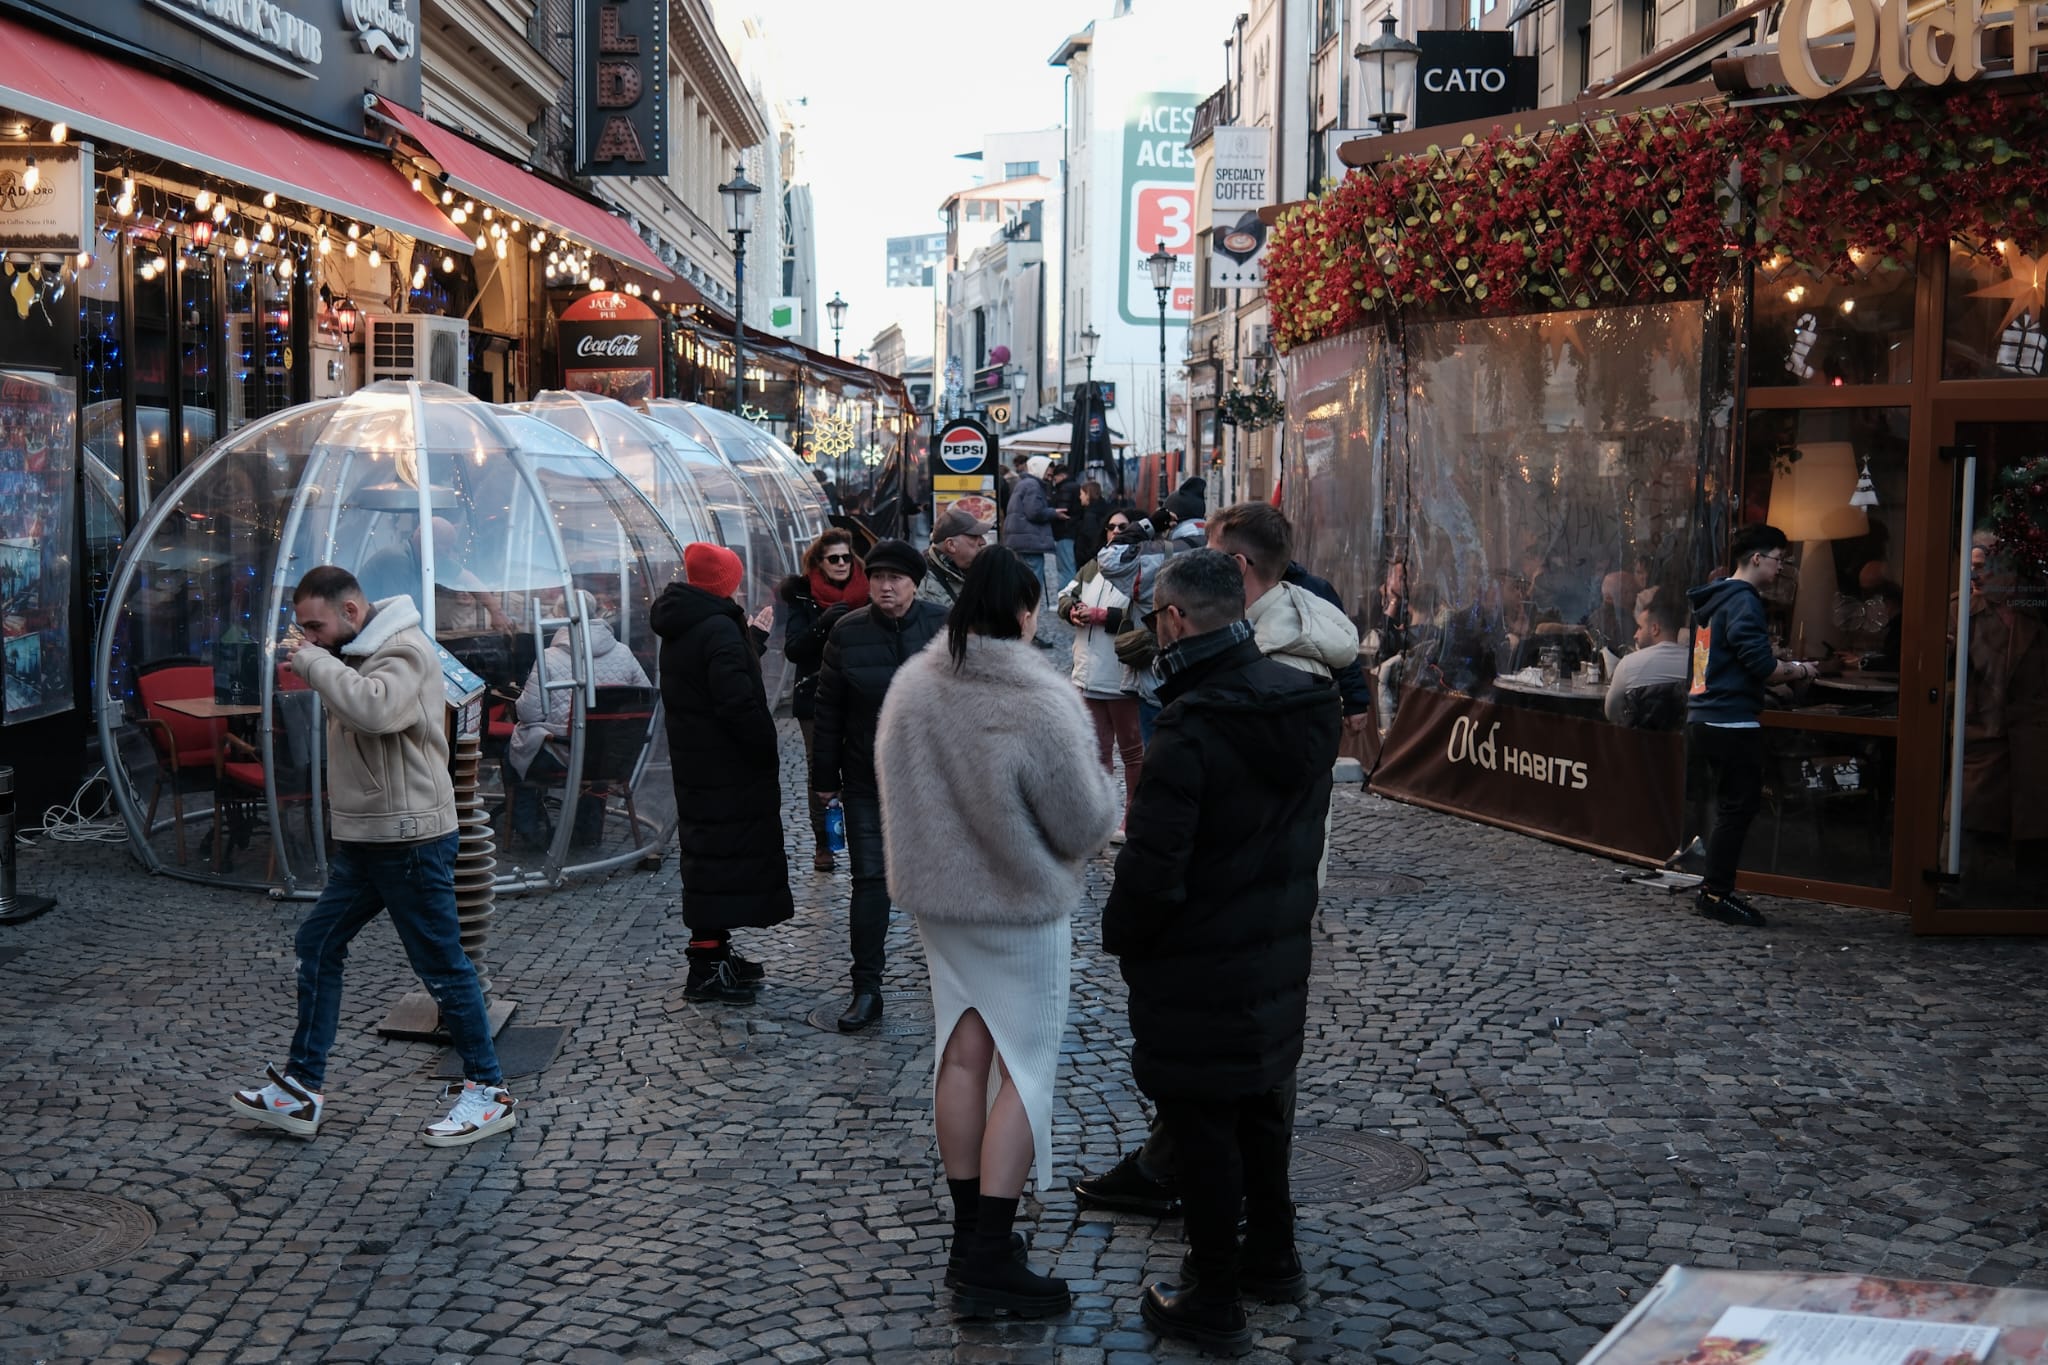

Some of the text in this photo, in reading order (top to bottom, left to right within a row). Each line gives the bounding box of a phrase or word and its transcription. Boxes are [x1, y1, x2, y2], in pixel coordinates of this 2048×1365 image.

[278, 11, 323, 64] PUB
[347, 0, 414, 60] Carlsberg
[1778, 0, 1986, 99] Old
[1423, 67, 1506, 93] CATO
[1215, 168, 1265, 181] SPECIALTY
[1215, 182, 1265, 200] COFFEE
[1154, 195, 1191, 248] 3
[1137, 259, 1192, 273] REERE
[588, 298, 627, 309] JACKS
[600, 311, 617, 319] PUB
[943, 445, 984, 455] PEPSI
[1447, 715, 1588, 790] Old HABITS
